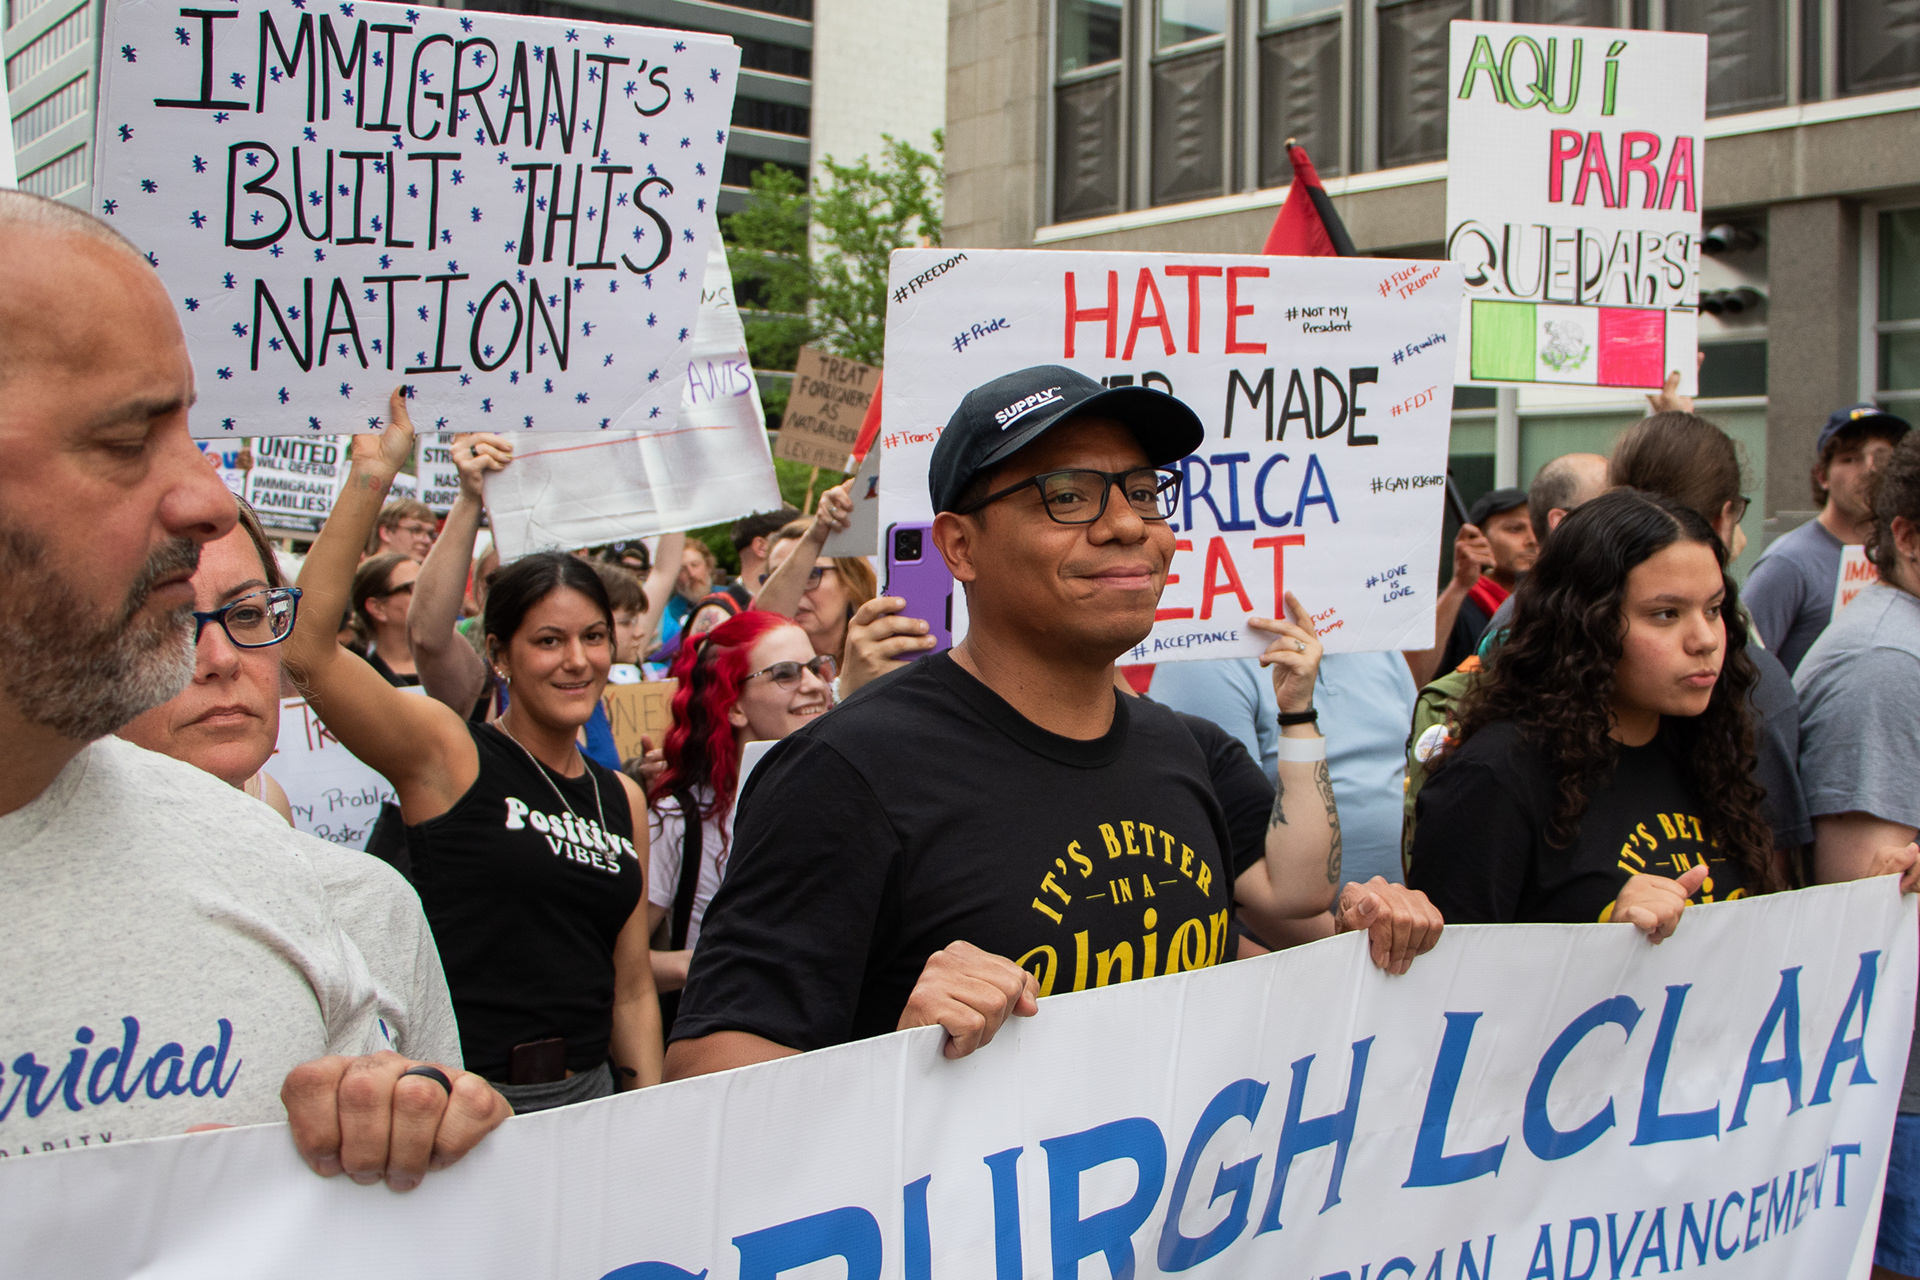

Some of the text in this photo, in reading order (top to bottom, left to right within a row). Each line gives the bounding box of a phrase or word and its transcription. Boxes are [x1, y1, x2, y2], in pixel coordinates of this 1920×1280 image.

[1548, 129, 1696, 212] PARA
[225, 142, 673, 274] BUILT THIS
[893, 253, 968, 303] #FREEDOM
[250, 273, 571, 375] NATION
[1063, 265, 1270, 361] HATE
[1329, 306, 1348, 320] MY
[952, 317, 1011, 352] #Pride
[820, 356, 868, 385] TREAT
[818, 402, 840, 421] AS
[1223, 367, 1379, 447] MADE
[1389, 385, 1438, 418] #FDT
[258, 437, 338, 465] UNITED
[288, 460, 336, 477] DEFEND
[251, 488, 332, 513] FAMILIES!
[253, 477, 334, 496] IMMIGRANT
[1383, 586, 1415, 603] LOVE
[505, 796, 638, 860] Positive
[545, 834, 621, 874] VIBES
[1099, 820, 1213, 897] BETTER
[1109, 873, 1156, 904] IN A
[0, 1015, 242, 1122] ridad
[1401, 949, 1883, 1188] LCLAA
[1525, 1141, 1862, 1280] ADVANCEMENT
